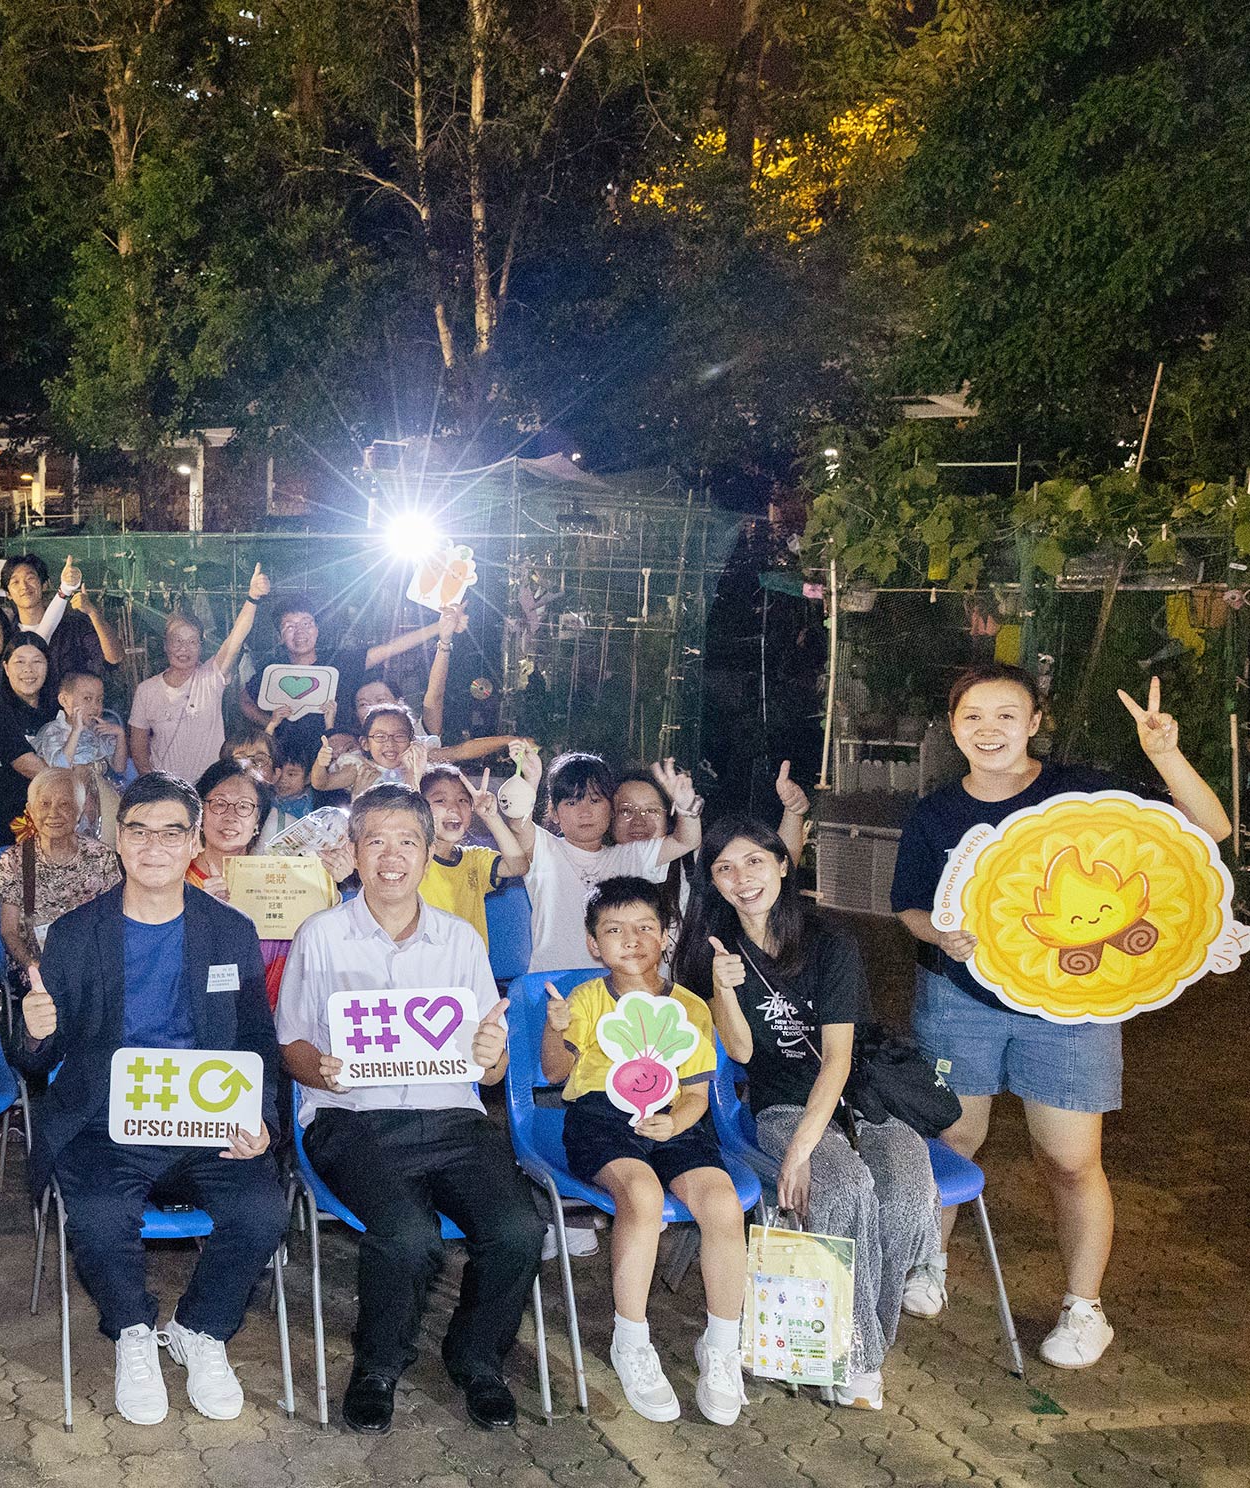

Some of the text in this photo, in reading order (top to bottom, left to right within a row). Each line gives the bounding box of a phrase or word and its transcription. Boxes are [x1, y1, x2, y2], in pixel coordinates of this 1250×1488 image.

[349, 1059, 468, 1079] SERENE OASIS
[123, 1119, 240, 1138] CFSC GREEN
